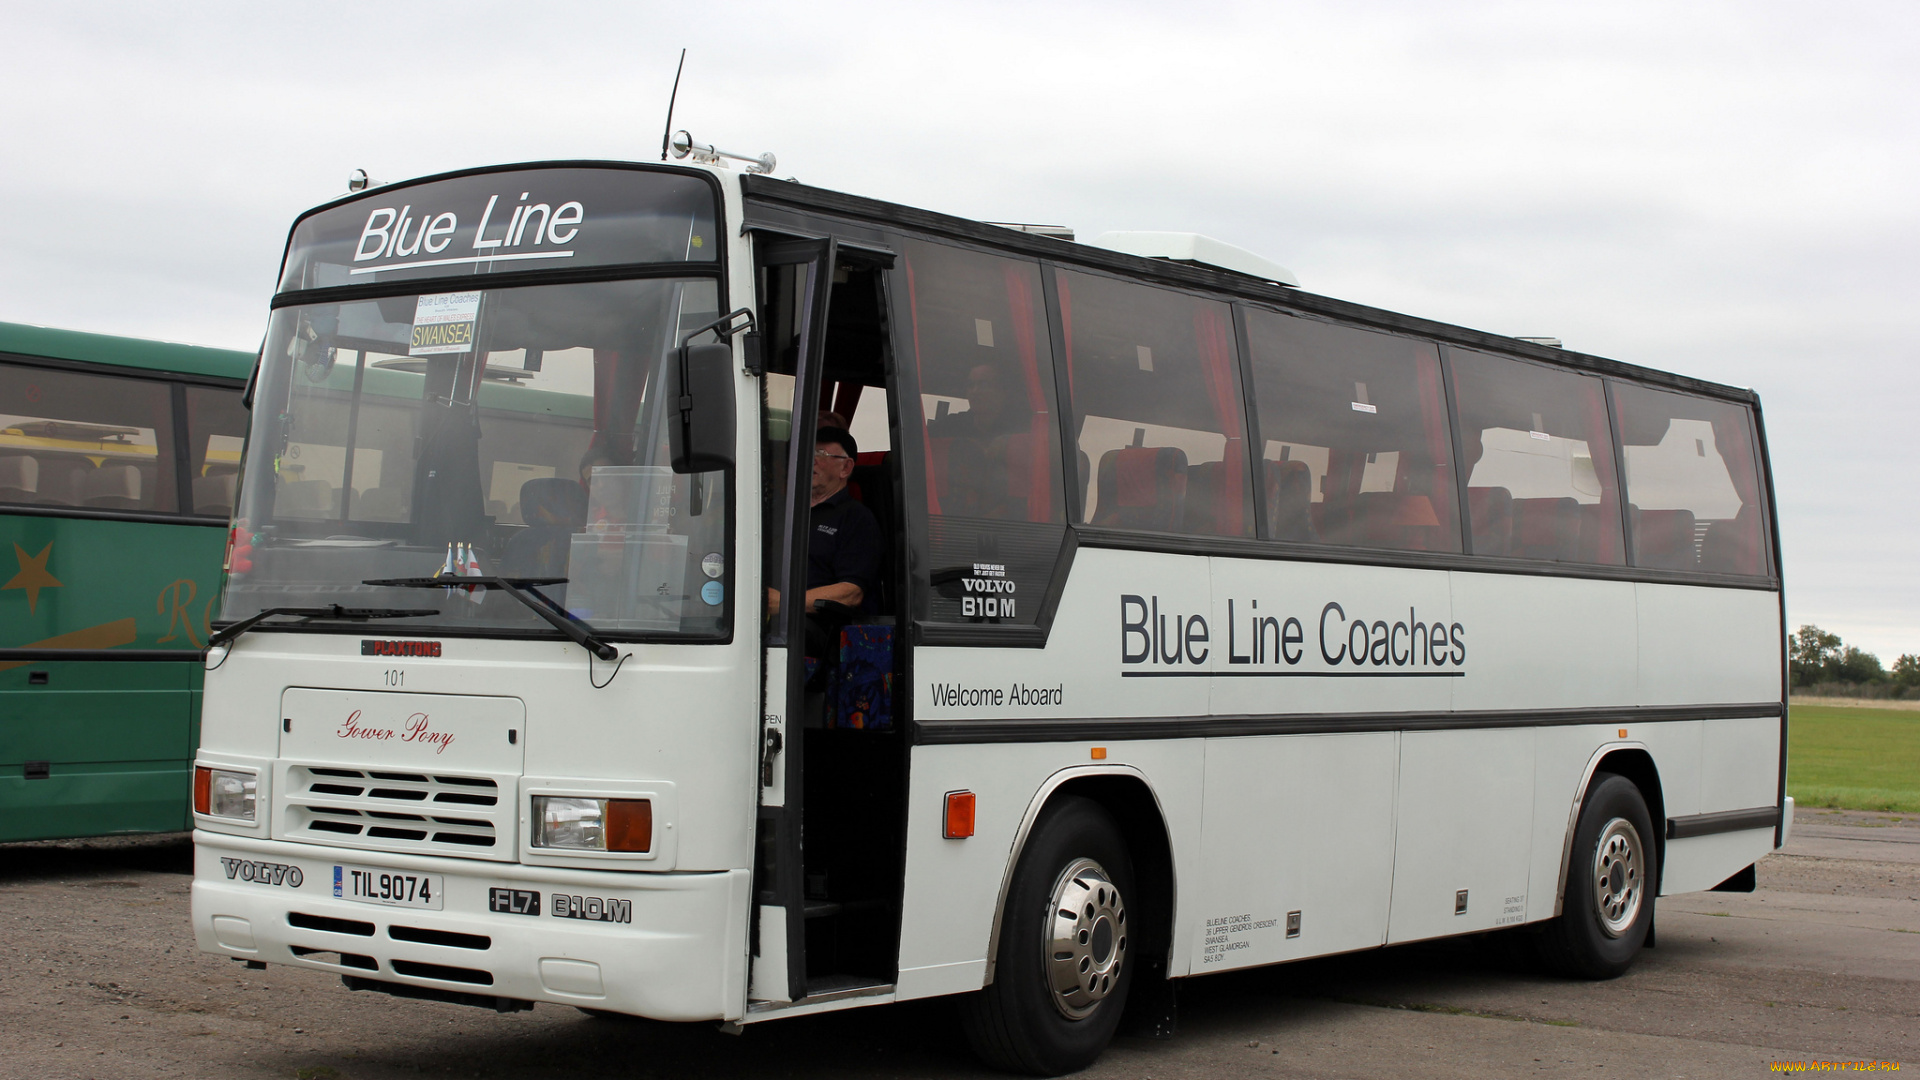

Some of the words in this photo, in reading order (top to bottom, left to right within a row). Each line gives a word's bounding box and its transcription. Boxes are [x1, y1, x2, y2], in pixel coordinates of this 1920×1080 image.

[353, 204, 458, 262] Blue
[472, 192, 584, 249] Line
[418, 296, 433, 307] Blue
[434, 295, 448, 306] Line
[449, 293, 479, 304] Coaches
[412, 323, 471, 346] SWANSEA
[962, 578, 1016, 594] VOLVO
[1121, 594, 1210, 665] Blue
[1228, 598, 1304, 666] Line
[1319, 601, 1466, 667] Coaches
[373, 641, 441, 657] PLAXTONS
[384, 669, 405, 687] 101
[931, 683, 1004, 707] Welcome
[1008, 683, 1063, 706] Aboard
[763, 714, 782, 724] PEN
[336, 709, 396, 740] Gower
[401, 712, 456, 755] Pony
[220, 856, 304, 888] VOLVO
[351, 870, 431, 904] TIL9074
[495, 889, 533, 914] FL7
[1206, 916, 1228, 928] BLUELINE
[1212, 925, 1229, 936] UPPER
[1229, 922, 1252, 933] GENDROS
[1204, 945, 1219, 954] WEST
